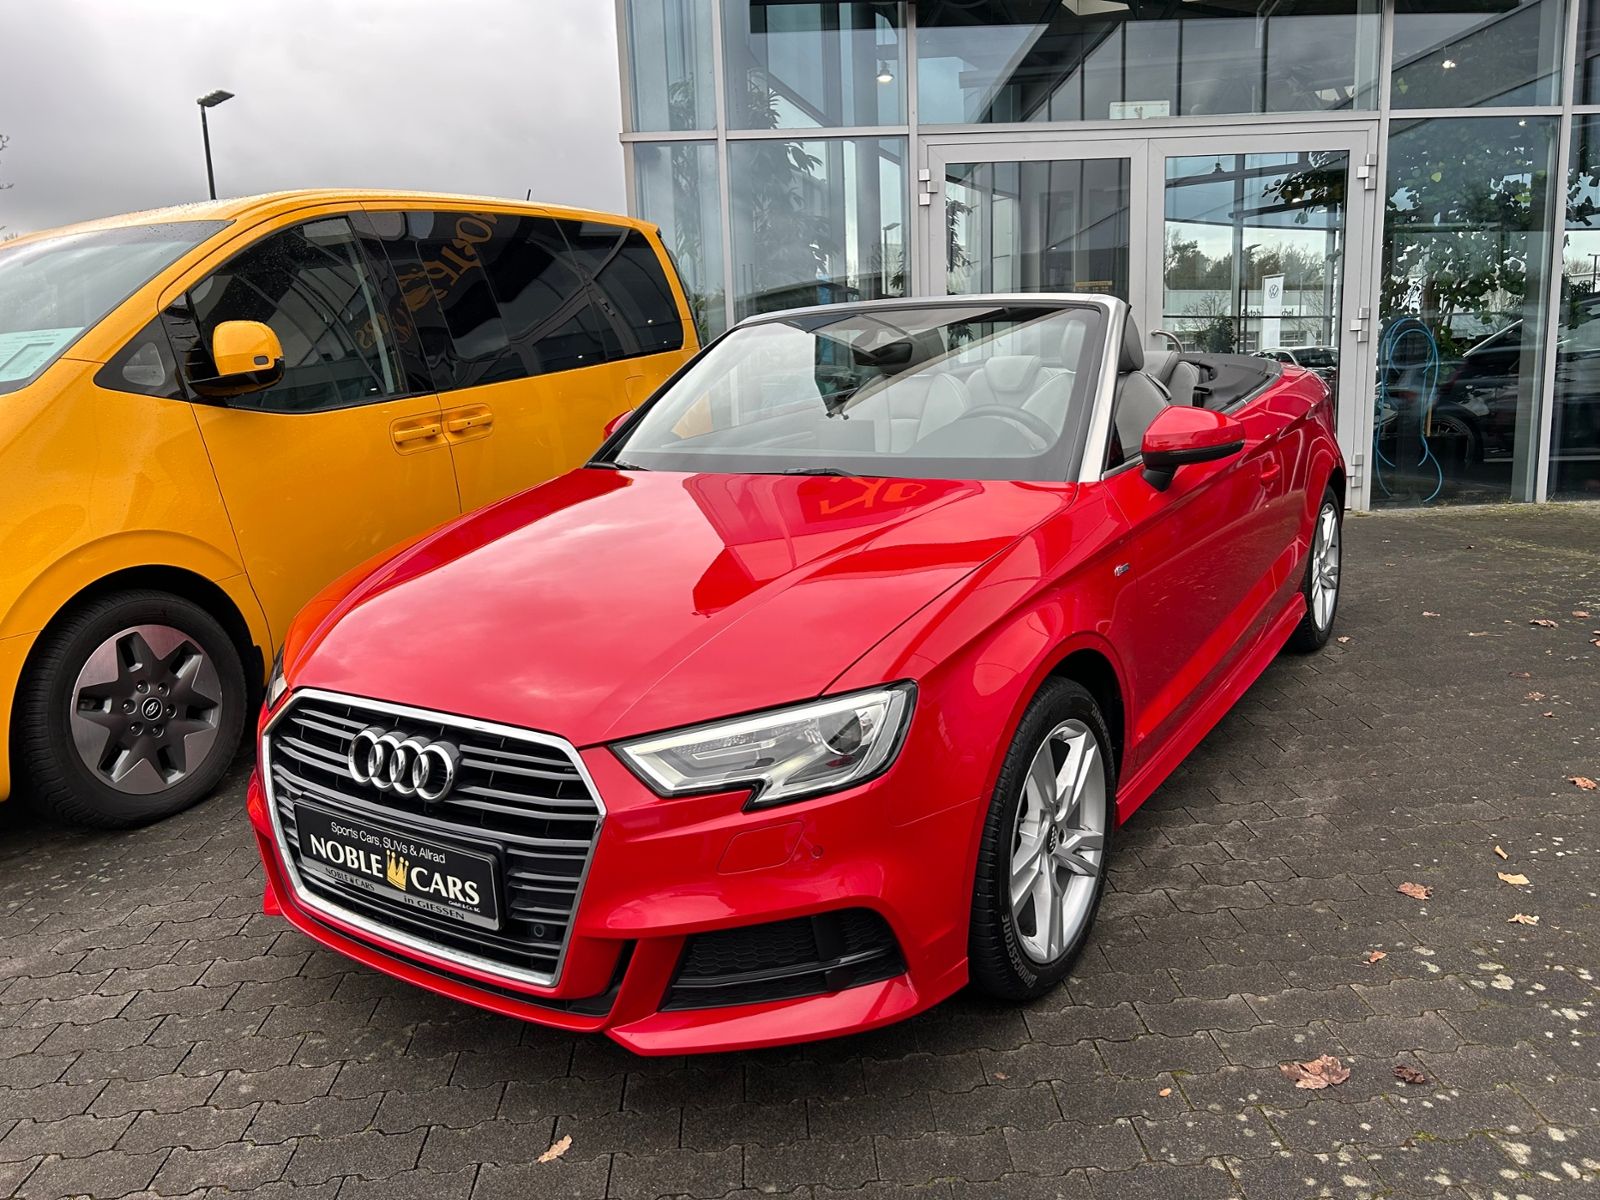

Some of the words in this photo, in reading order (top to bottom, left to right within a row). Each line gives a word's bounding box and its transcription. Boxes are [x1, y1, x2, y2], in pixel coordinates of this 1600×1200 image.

[331, 821, 358, 840] Sports
[409, 846, 417, 856] &
[419, 847, 446, 864] Allrad
[310, 833, 384, 878] NOBLE
[410, 867, 481, 905] CARS
[325, 867, 348, 882] NOBLE
[354, 878, 375, 891] CARS
[403, 895, 415, 905] in
[417, 900, 465, 920] GIESSEN
